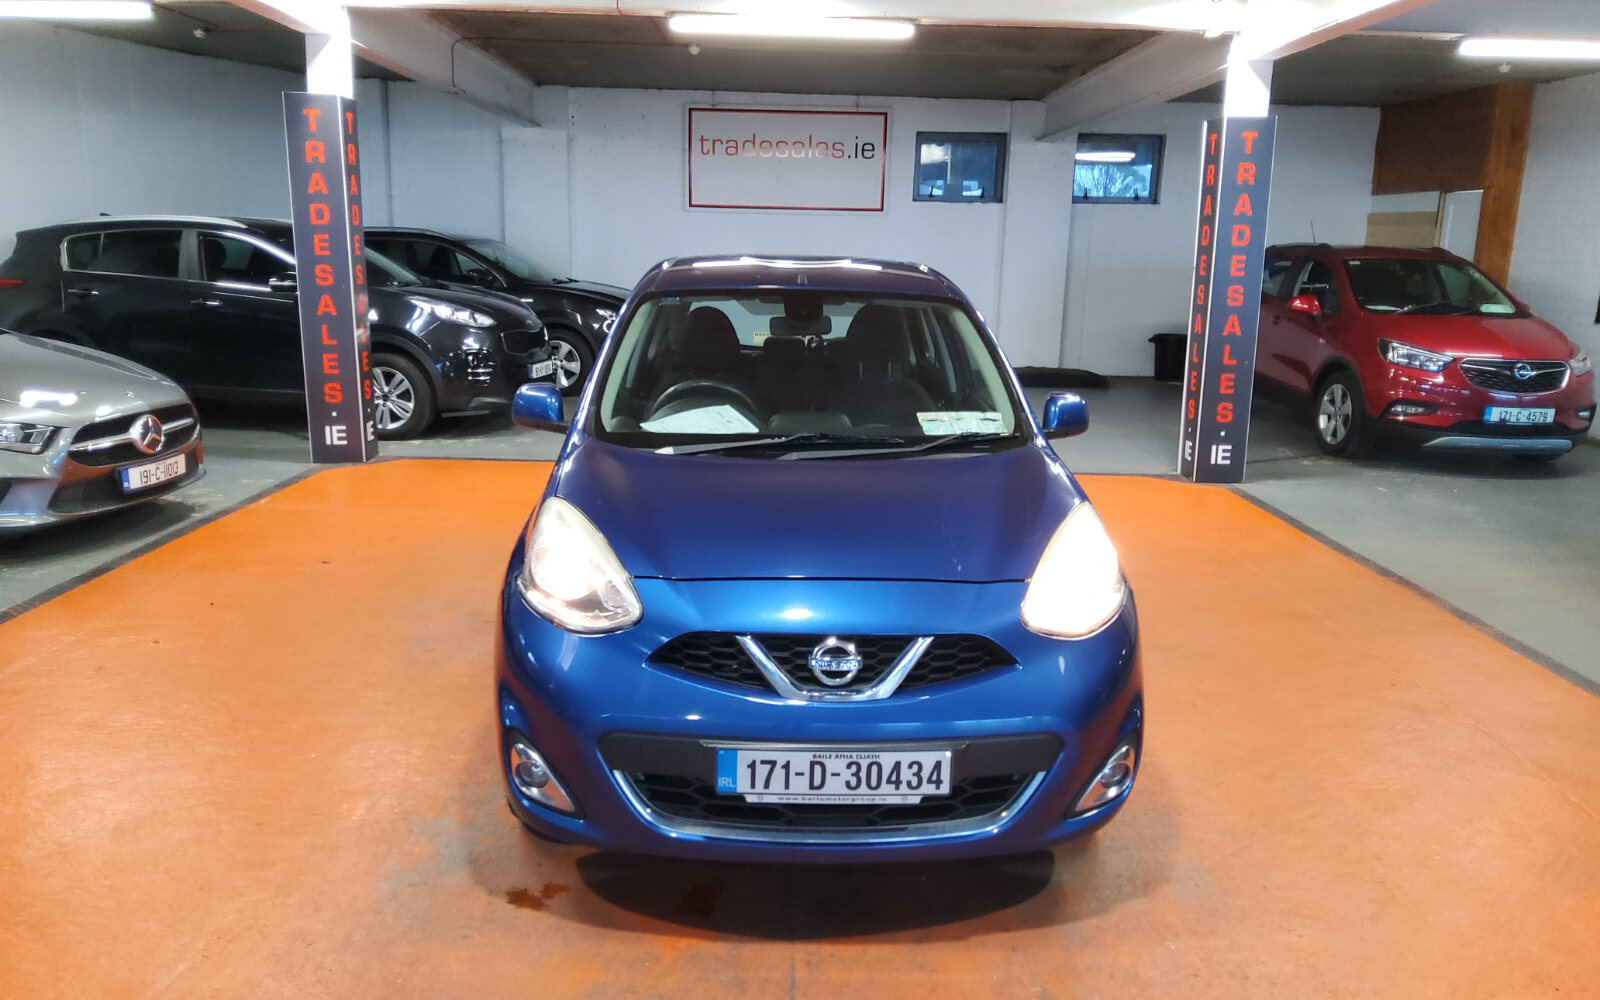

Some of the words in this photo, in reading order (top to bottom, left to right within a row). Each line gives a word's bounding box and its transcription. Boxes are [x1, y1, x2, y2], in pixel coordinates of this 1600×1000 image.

[699, 133, 875, 160] tradesales.ie
[302, 108, 348, 445] TRADESALES.IE
[1210, 131, 1258, 465] TRADESALES.IE
[814, 660, 858, 669] NISSAN
[718, 776, 736, 788] IRL
[747, 759, 943, 791] 171-D-30434
